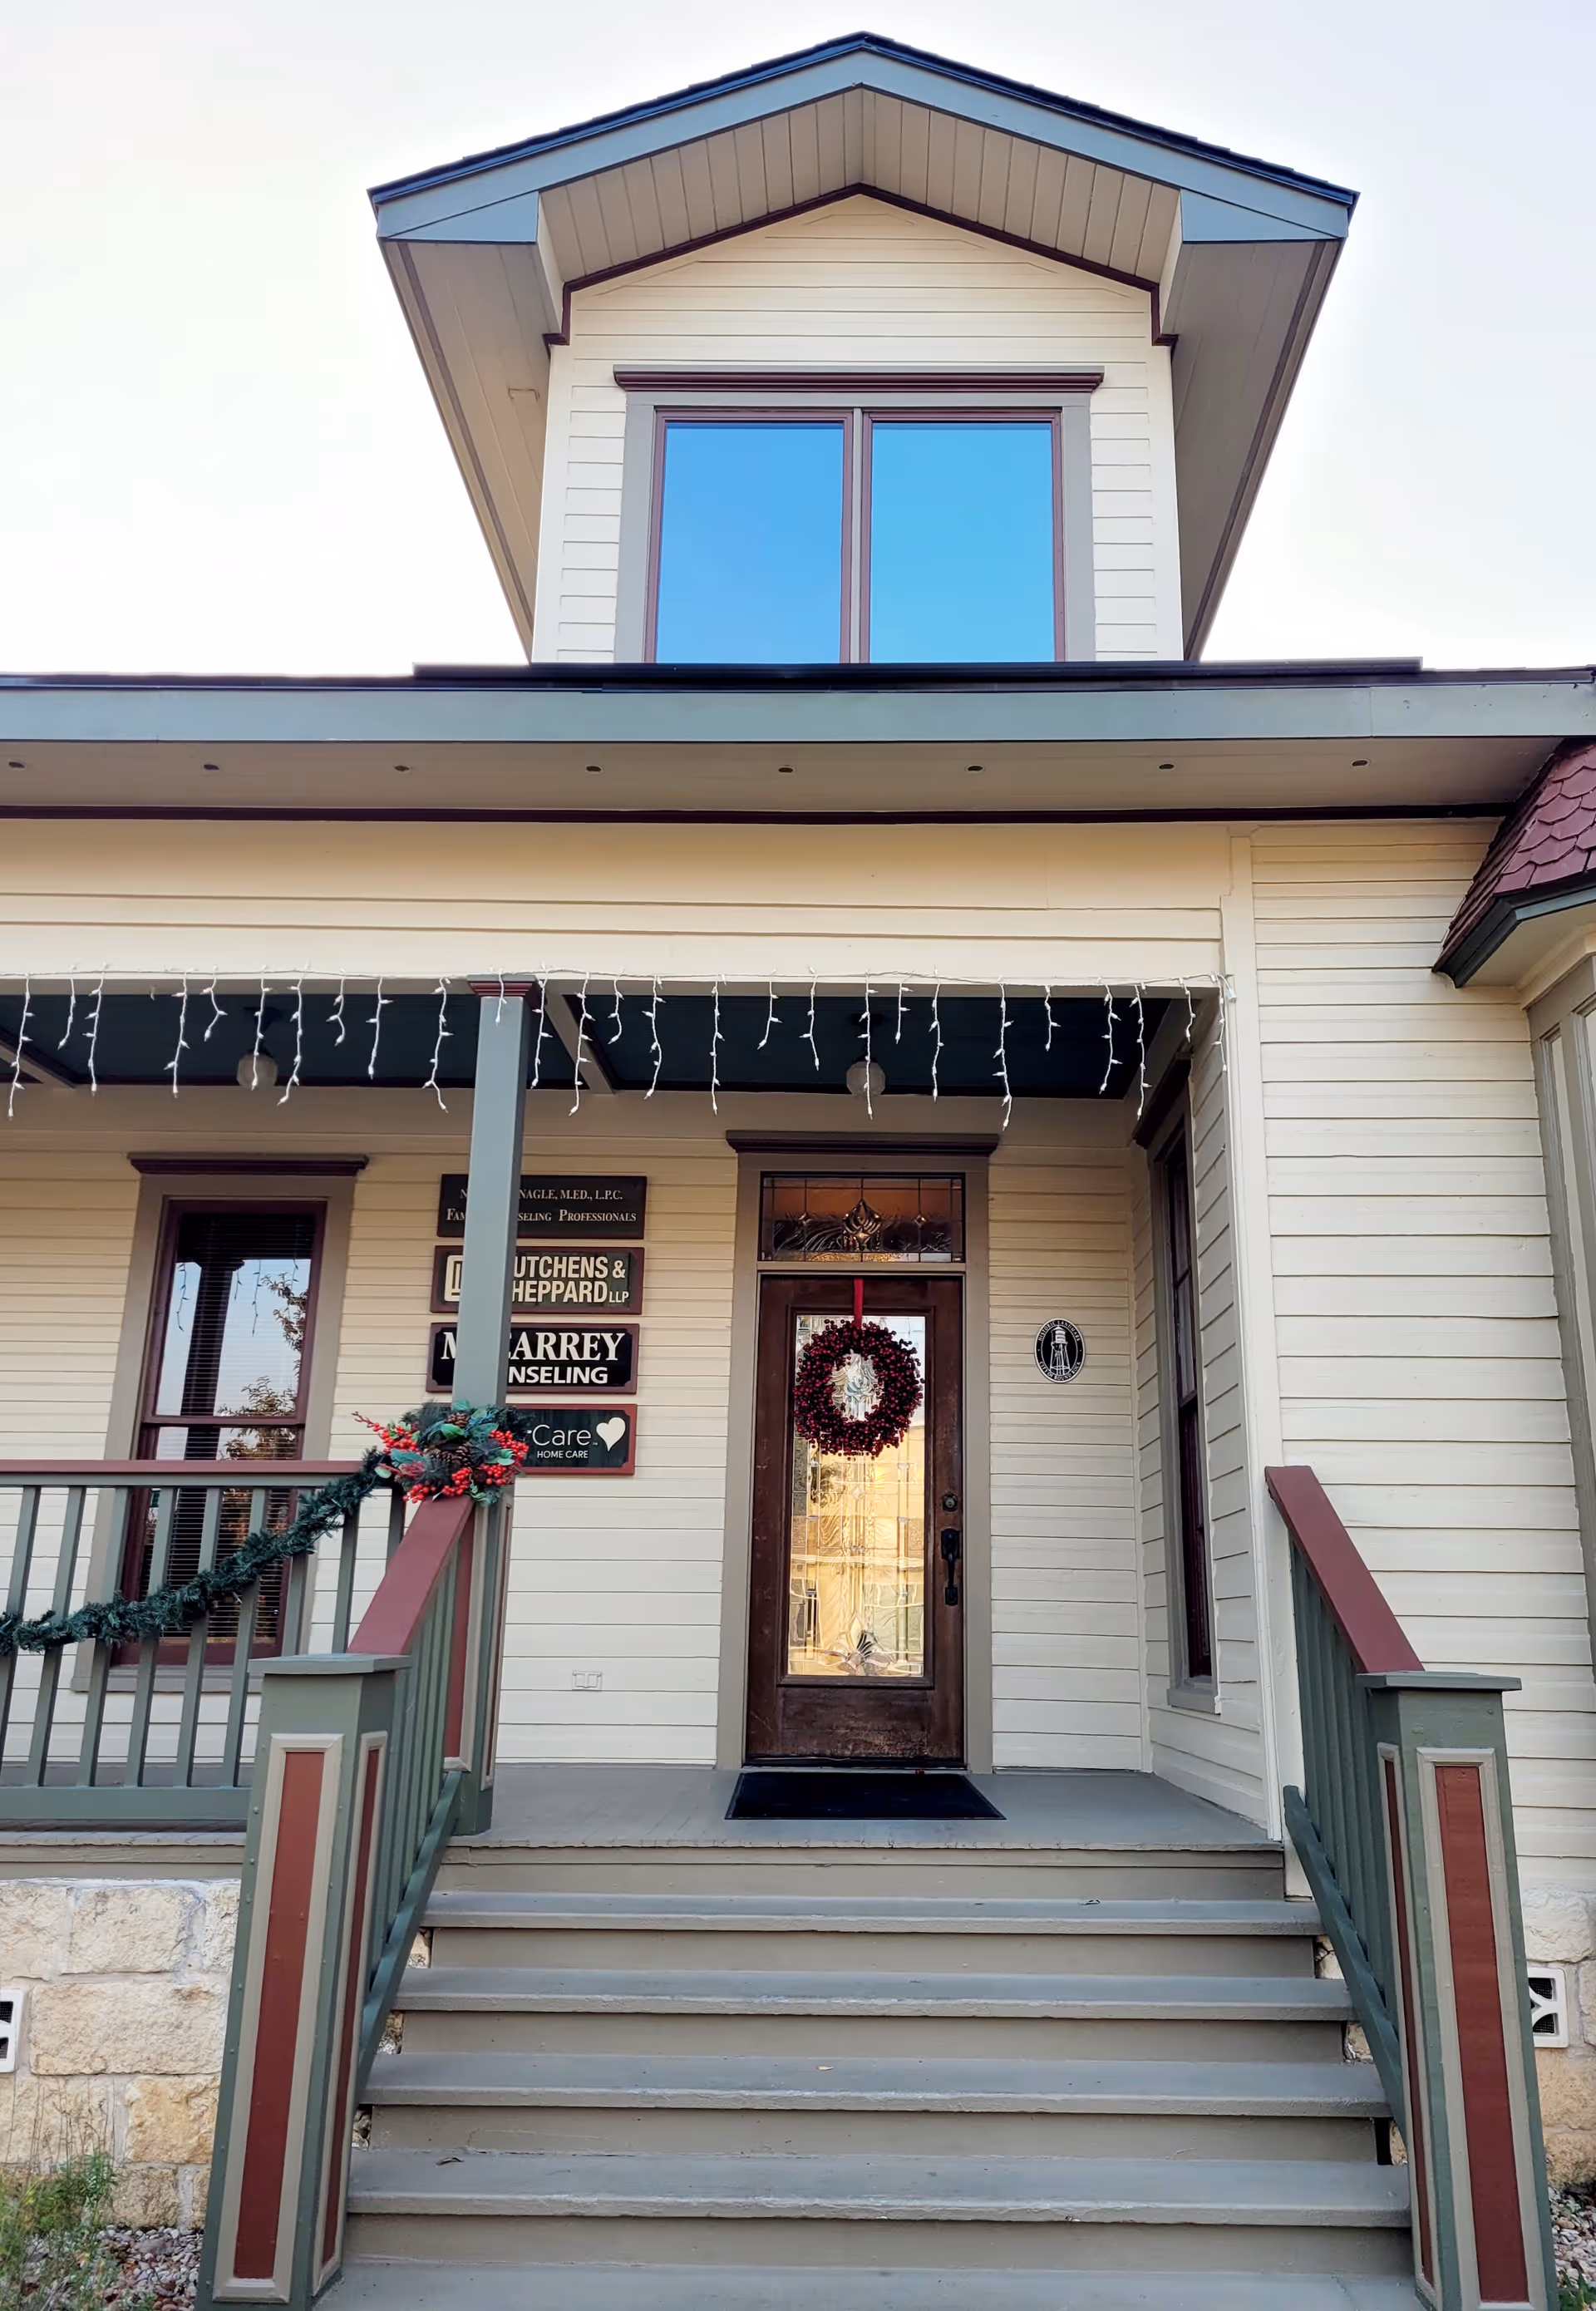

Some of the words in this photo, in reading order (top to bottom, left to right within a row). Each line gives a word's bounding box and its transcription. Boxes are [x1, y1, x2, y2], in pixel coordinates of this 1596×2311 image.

[595, 1190, 623, 1200] L.P.C.
[517, 1212, 552, 1222] SELING
[514, 1255, 608, 1279] UTCHENS
[612, 1259, 626, 1279] &
[512, 1280, 608, 1303] HEPPARD
[608, 1291, 629, 1303] LLP
[1037, 1320, 1056, 1342] HISTORIC
[441, 1331, 625, 1361] MARREY
[509, 1366, 608, 1384] NSELING
[1054, 1372, 1071, 1381] ROUND
[537, 1450, 564, 1459] HOME
[565, 1450, 589, 1459] CARE
